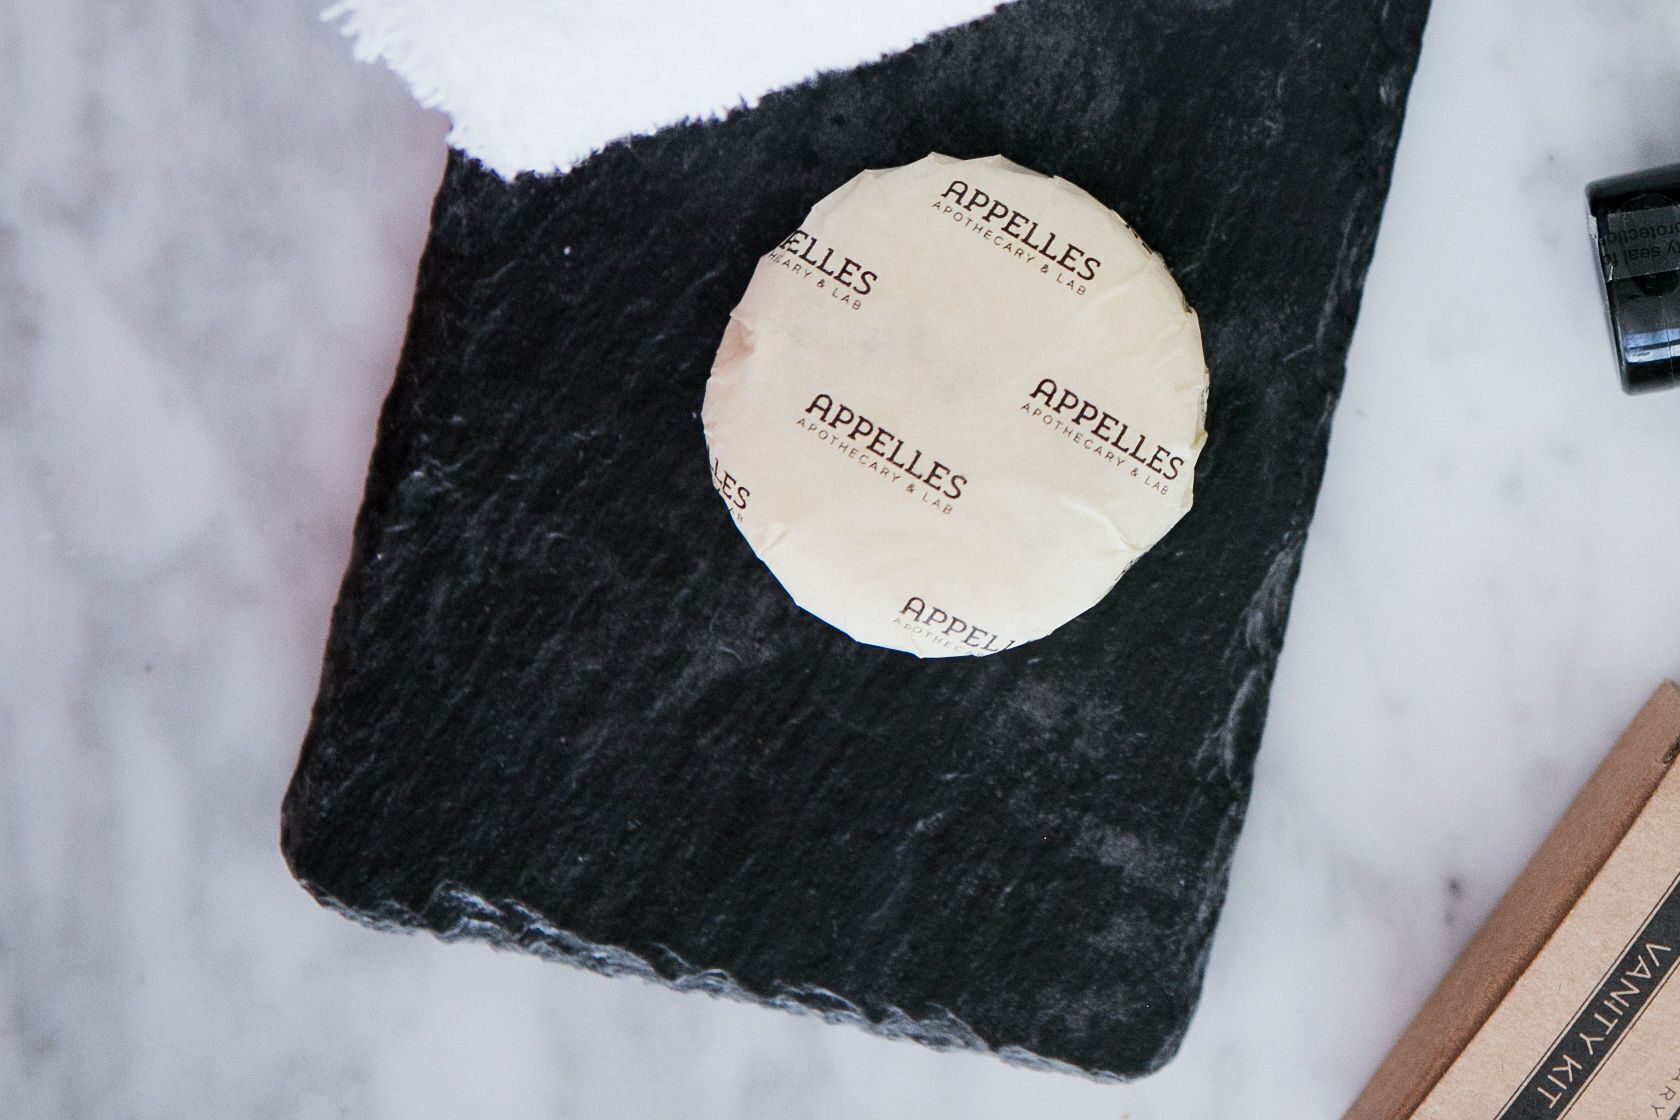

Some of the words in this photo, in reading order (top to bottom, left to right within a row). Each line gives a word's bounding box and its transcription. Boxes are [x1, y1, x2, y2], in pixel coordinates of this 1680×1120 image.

[931, 200, 1036, 265] APOTHECARY
[1039, 263, 1050, 274] &
[1056, 269, 1088, 296] LAB
[941, 180, 1102, 281] APPELLES
[816, 278, 825, 288] &
[832, 288, 862, 311] LAB
[795, 418, 901, 484] APOTHECARY
[905, 482, 916, 493] &
[921, 487, 953, 515] LAB
[804, 393, 969, 500] APPELLES
[1020, 402, 1126, 466] APOTHECARY
[1130, 467, 1140, 477] &
[1144, 471, 1169, 495] LAB
[1028, 378, 1185, 481] APPELLES
[1580, 942, 1672, 1055] VANITY
[1537, 1054, 1583, 1109] KIT
